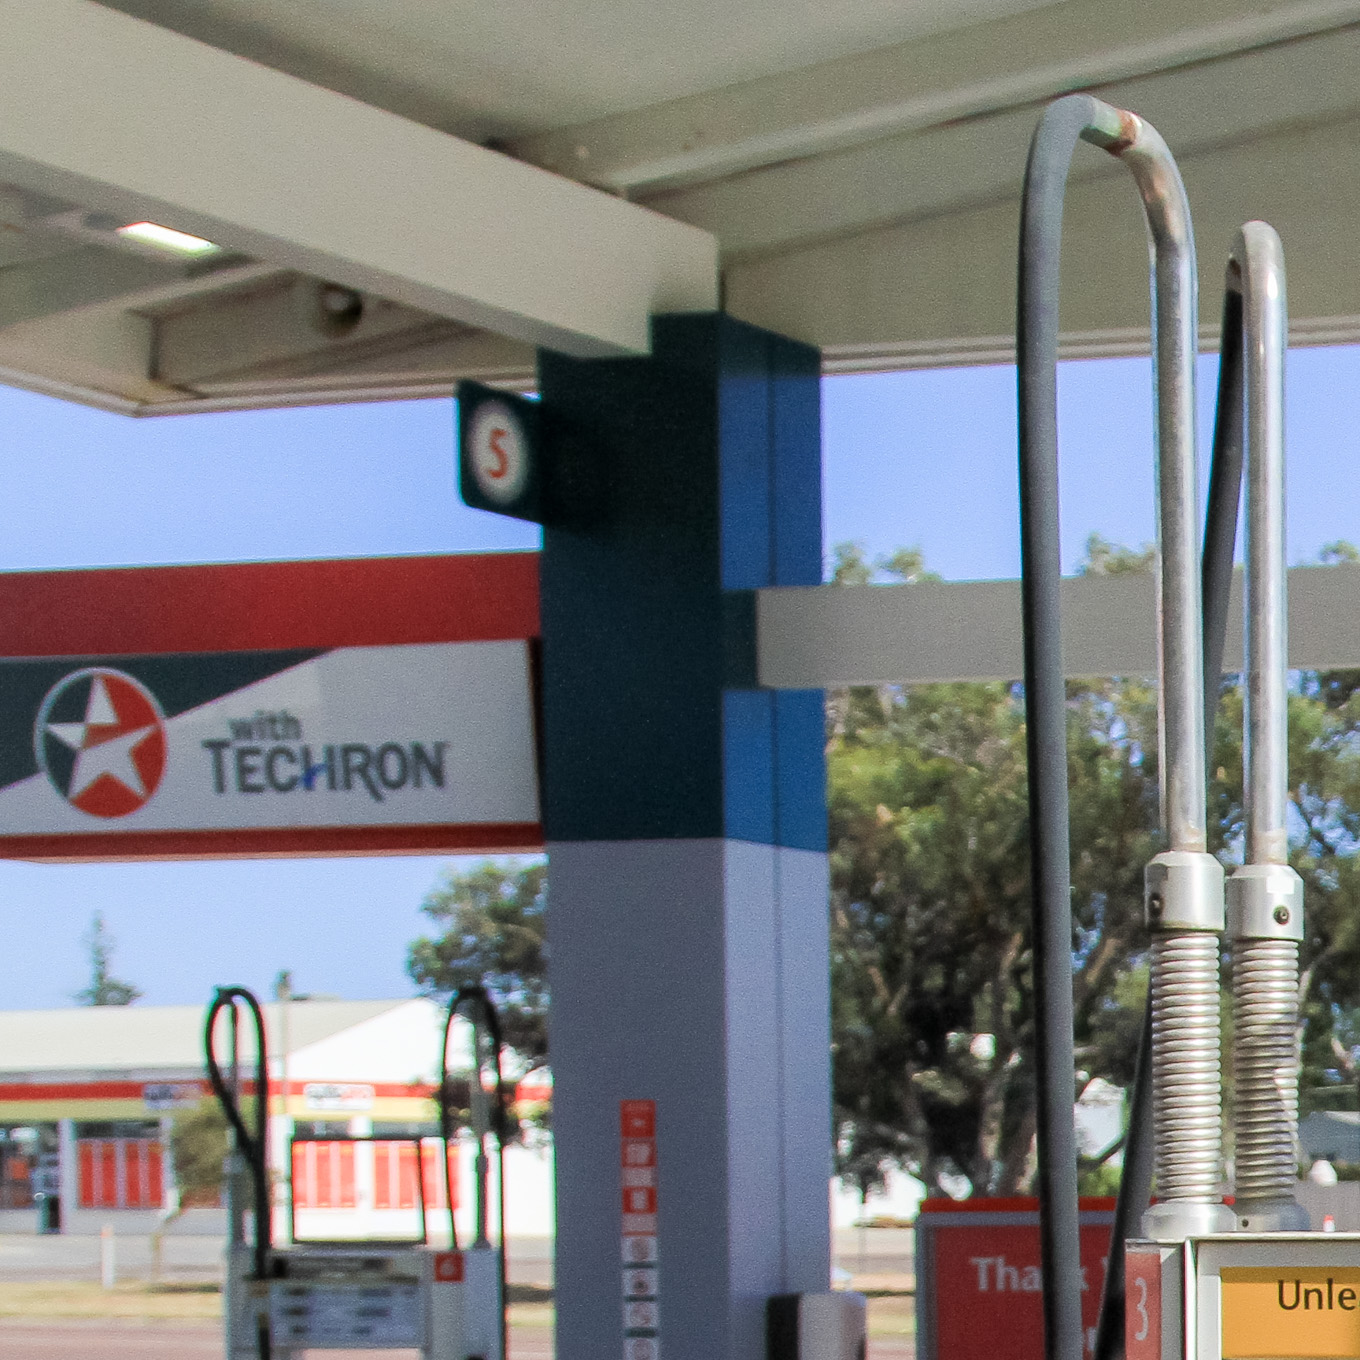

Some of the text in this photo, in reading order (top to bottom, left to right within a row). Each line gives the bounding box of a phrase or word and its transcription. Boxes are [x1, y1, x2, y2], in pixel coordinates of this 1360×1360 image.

[230, 708, 302, 742] with
[202, 739, 448, 801] TECHRON
[970, 1256, 1089, 1292] Tha
[1134, 1277, 1148, 1341] 3
